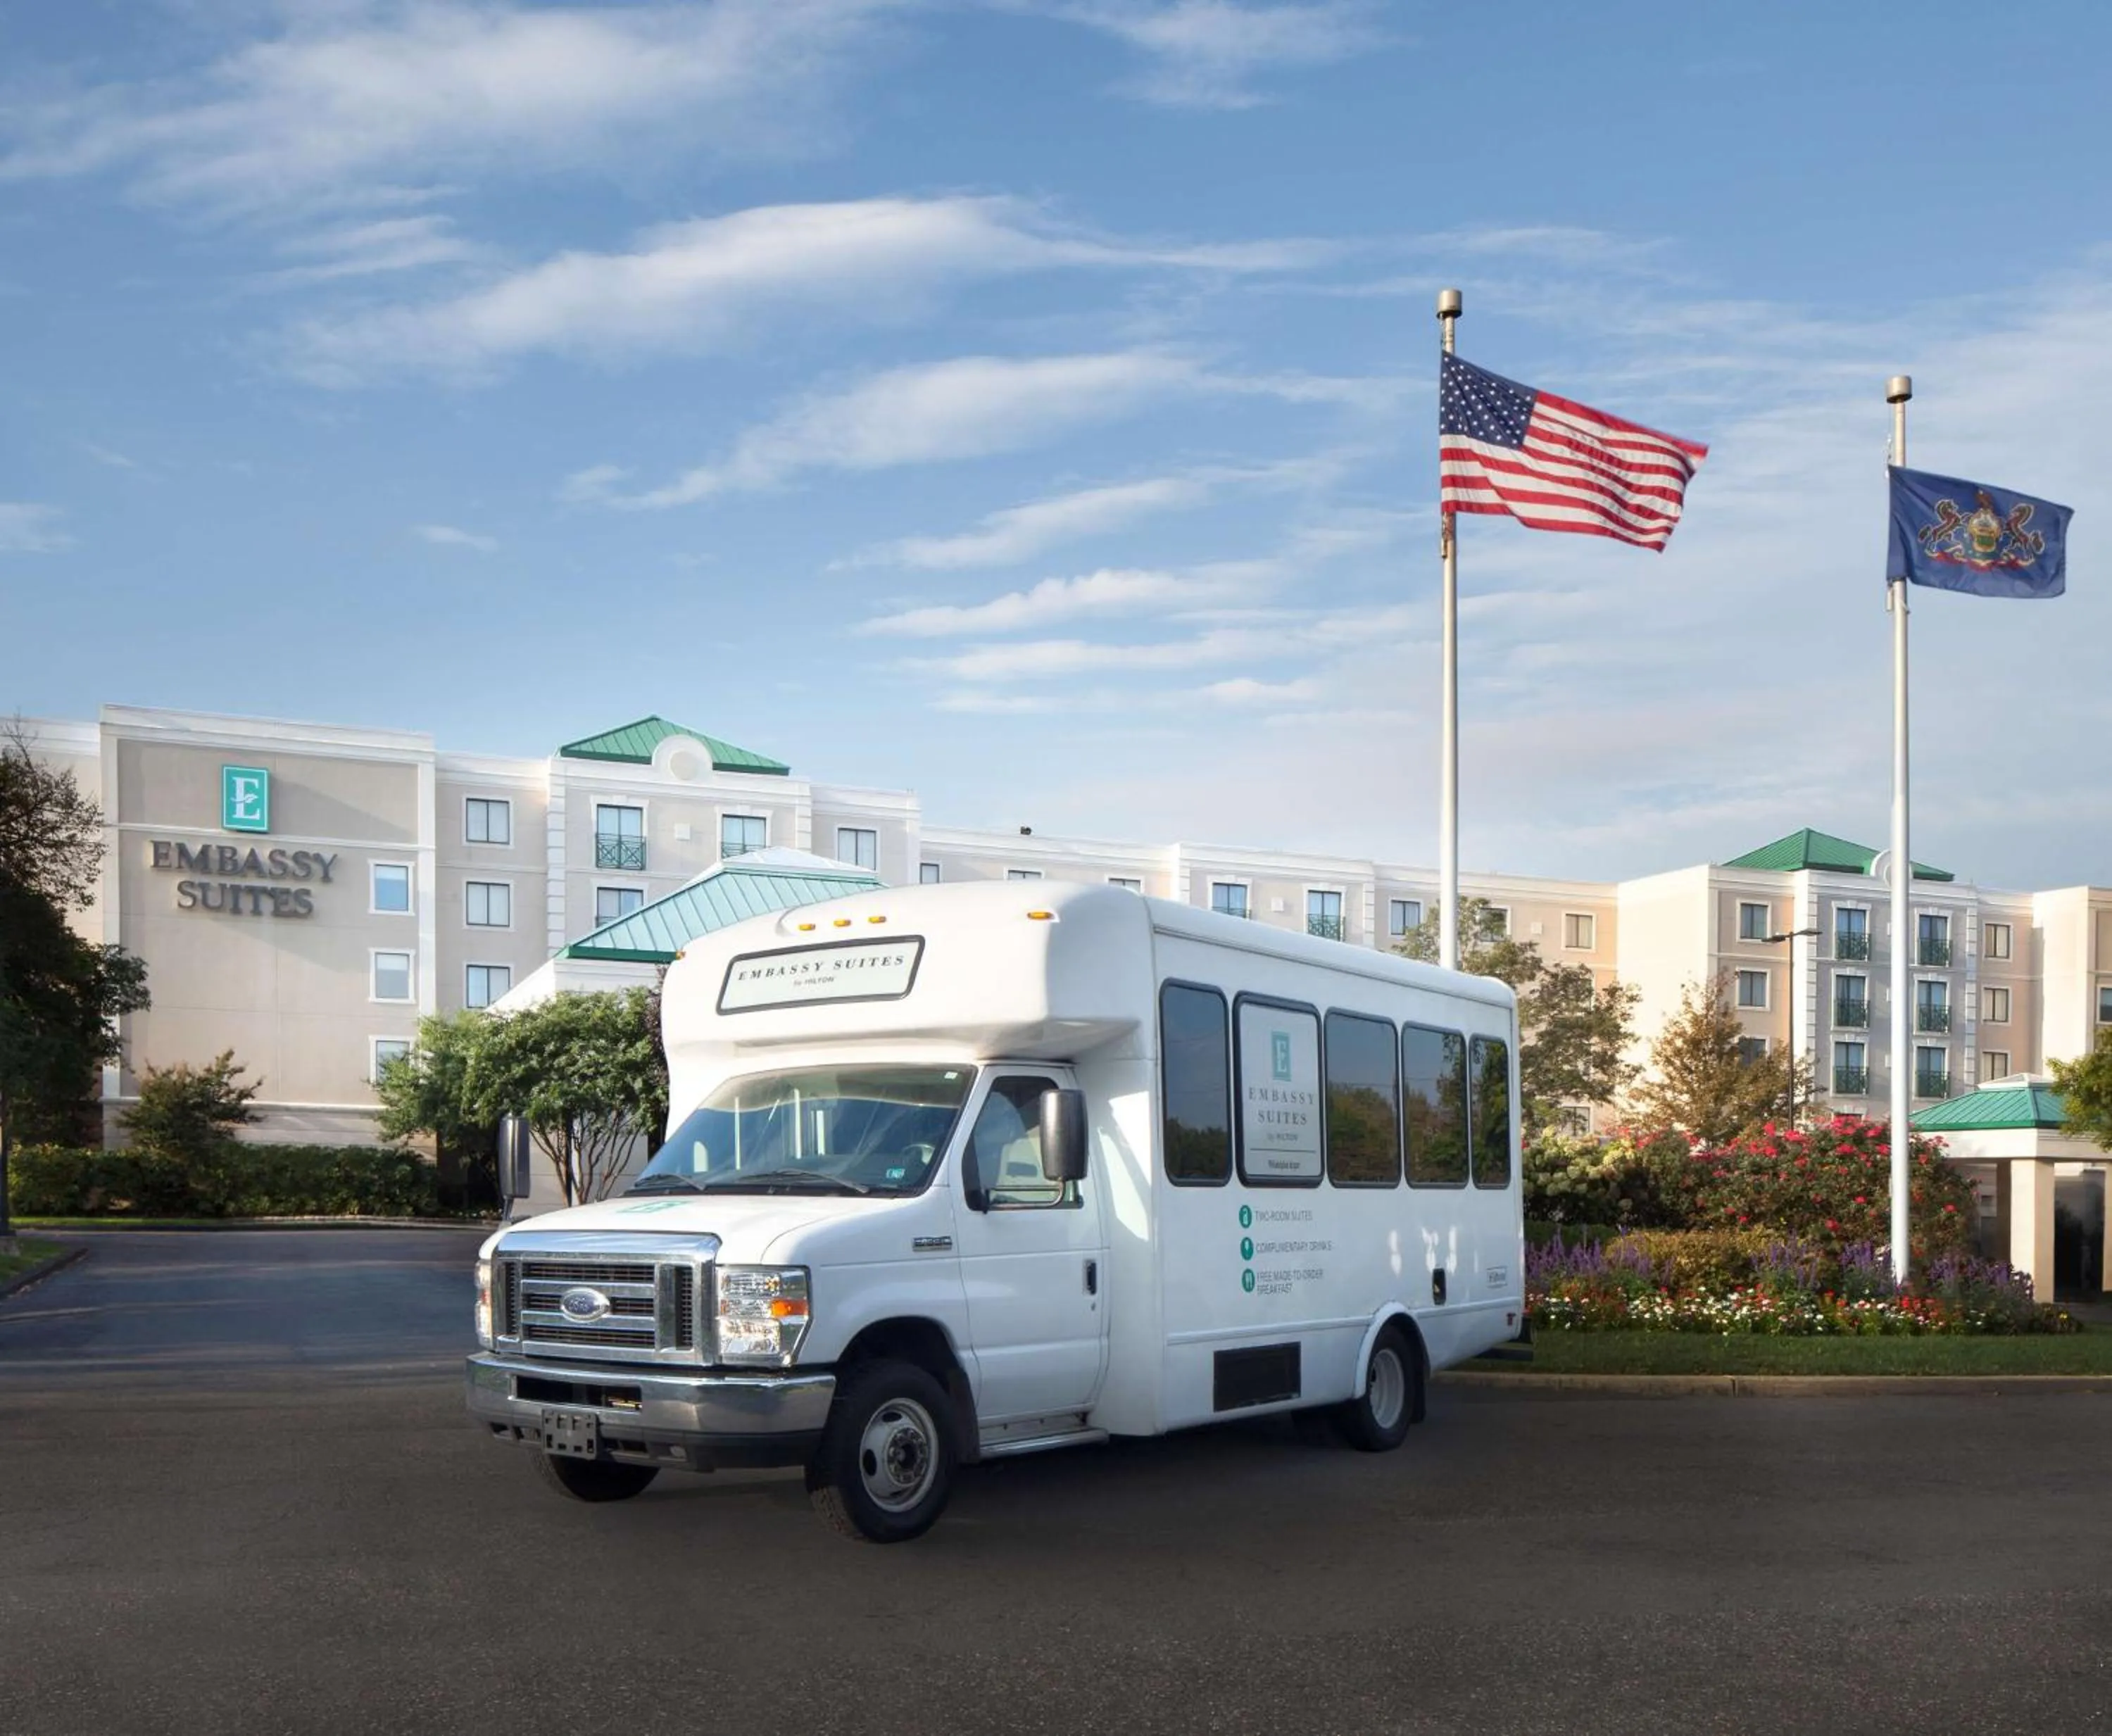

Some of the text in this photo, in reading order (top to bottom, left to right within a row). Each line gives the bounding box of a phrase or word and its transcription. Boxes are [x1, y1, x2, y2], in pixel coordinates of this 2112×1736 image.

[232, 776, 260, 820] E
[150, 841, 338, 883] EMBASSY
[177, 880, 314, 917] SUITES
[738, 955, 904, 981] EMBASSY SUITES
[1249, 1087, 1315, 1105] EMBASSY
[1257, 1109, 1308, 1126] SUITES
